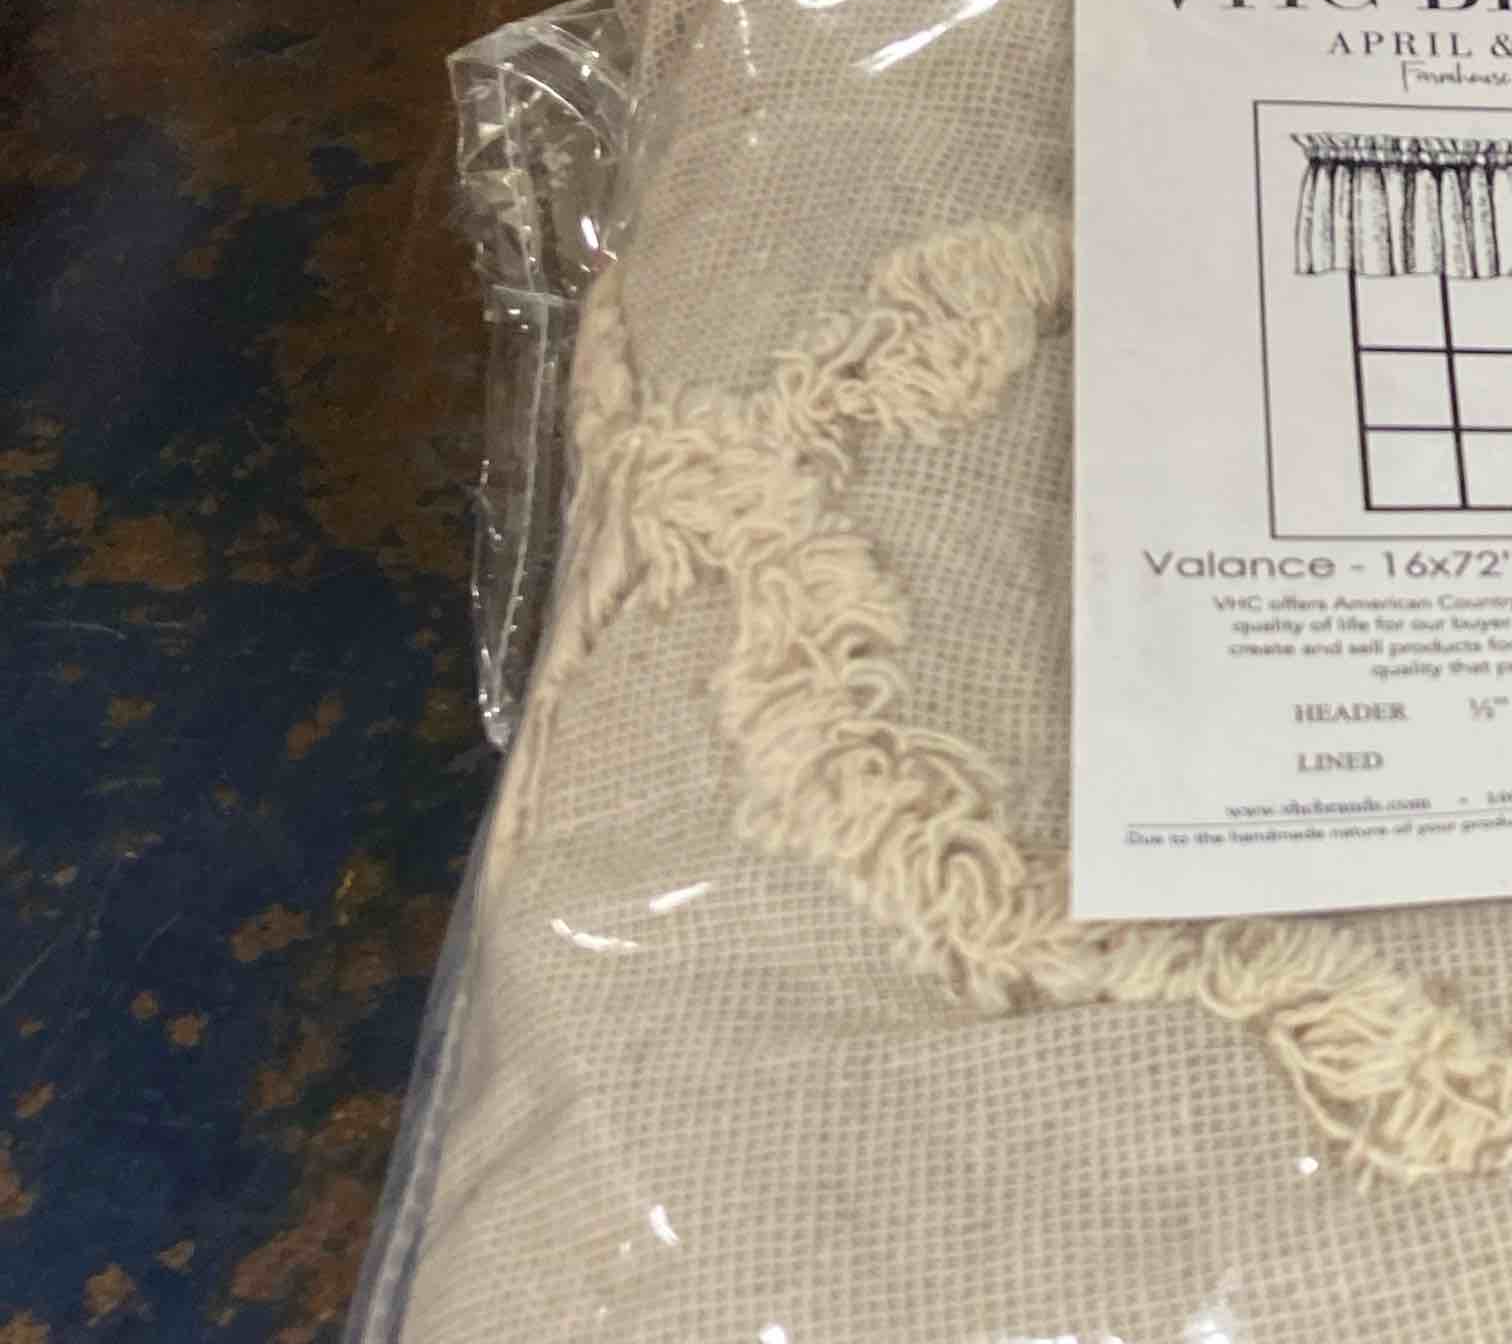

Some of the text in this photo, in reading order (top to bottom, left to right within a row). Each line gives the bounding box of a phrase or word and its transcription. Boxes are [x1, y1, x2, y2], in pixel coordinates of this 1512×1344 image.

[1327, 29, 1474, 58] APRIL
[1401, 60, 1511, 93] Farmhouse
[1144, 548, 1336, 579] Valance
[1213, 594, 1262, 610] VHC
[1268, 593, 1327, 610] offers
[1333, 593, 1432, 610] American
[1232, 616, 1303, 636] quality
[1309, 616, 1332, 632] of
[1338, 615, 1370, 632] life
[1375, 615, 1405, 632] for
[1411, 619, 1445, 631] our
[1451, 614, 1512, 634] buyer
[1228, 641, 1296, 656] create
[1302, 639, 1343, 655] and
[1348, 638, 1383, 655] sell
[1389, 636, 1482, 659] products
[1370, 660, 1442, 680] quality
[1449, 659, 1490, 675] that
[1293, 701, 1409, 724] HEADER
[1296, 752, 1384, 774] LINED
[1127, 830, 1164, 846] Due
[1169, 833, 1188, 845] to
[1194, 830, 1224, 844] the
[1229, 826, 1324, 843] handmade
[1329, 824, 1389, 839] nature
[1392, 820, 1413, 836] of
[1416, 821, 1457, 837] your
